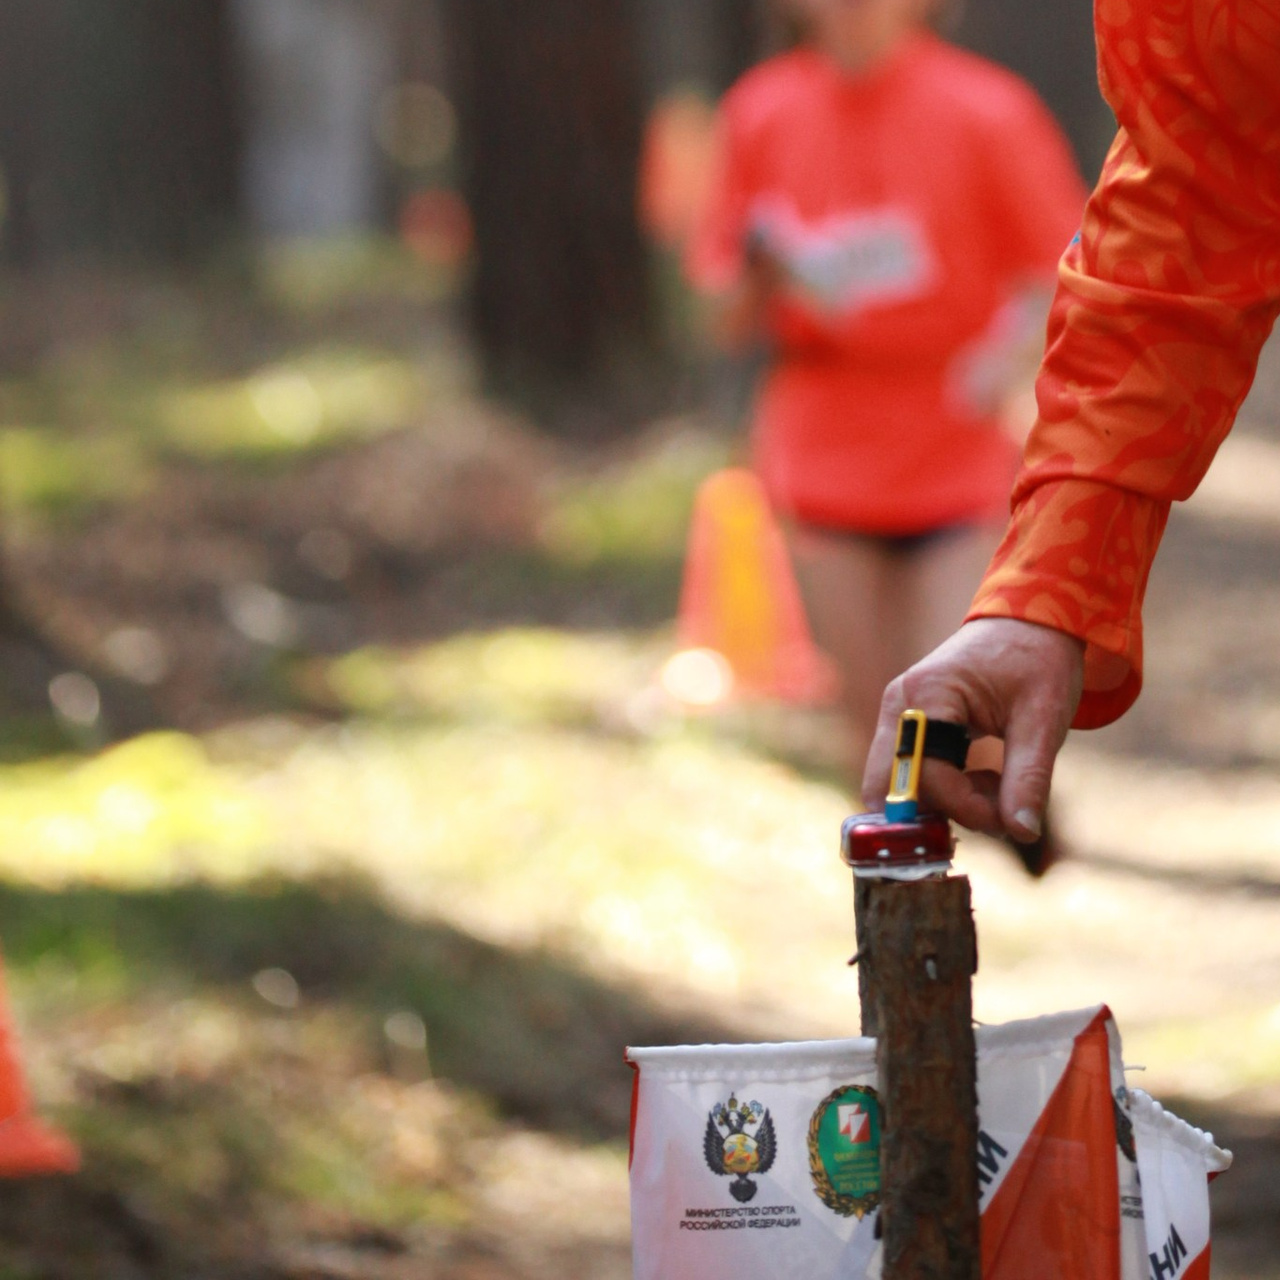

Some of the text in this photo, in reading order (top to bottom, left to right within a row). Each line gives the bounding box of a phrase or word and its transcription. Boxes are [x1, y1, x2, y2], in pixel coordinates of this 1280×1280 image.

[685, 1205, 796, 1218] МИНИСТЕРСТВО СПОРТА
[679, 1217, 800, 1230] РОССИЙСКОЙ ФЕДЕРАЦИИ
